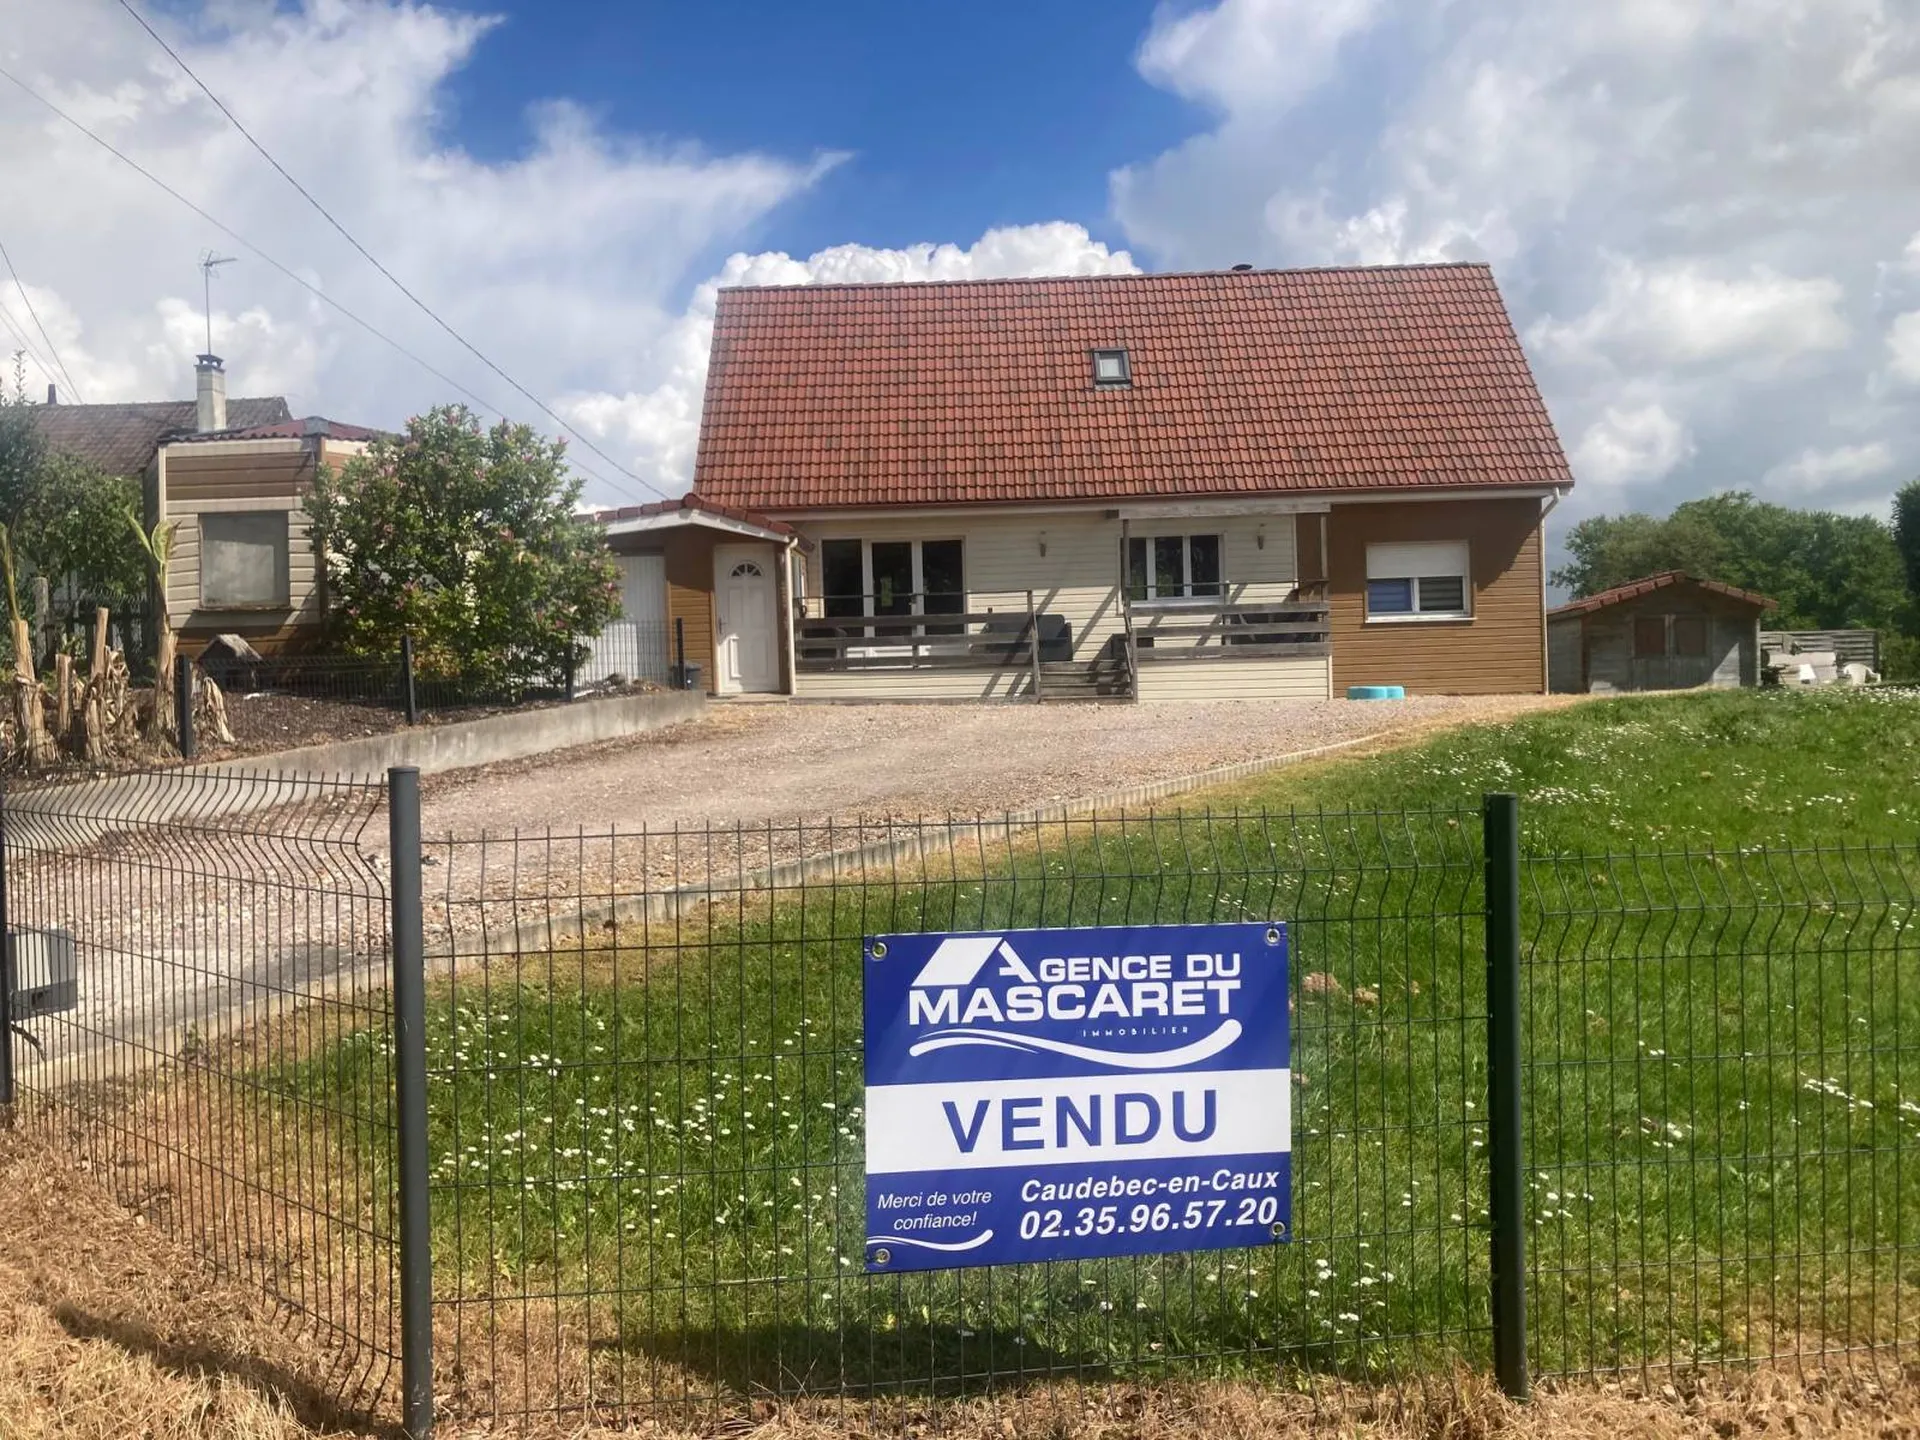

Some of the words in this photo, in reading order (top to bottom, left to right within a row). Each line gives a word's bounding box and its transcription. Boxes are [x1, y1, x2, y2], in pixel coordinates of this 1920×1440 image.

[998, 940, 1171, 983] AGENCE
[1187, 953, 1241, 978] DU
[908, 980, 1241, 1026] MASCARET
[1082, 1026, 1188, 1038] IMMOBILIER
[942, 1089, 1217, 1153] VENDU
[877, 1192, 924, 1210] Merci
[927, 1192, 948, 1207] de
[952, 1189, 992, 1206] votre
[1021, 1168, 1280, 1203] Caudebec-en-Caux
[893, 1211, 978, 1231] confiance!
[1019, 1196, 1278, 1240] 02.35.96.57.20
